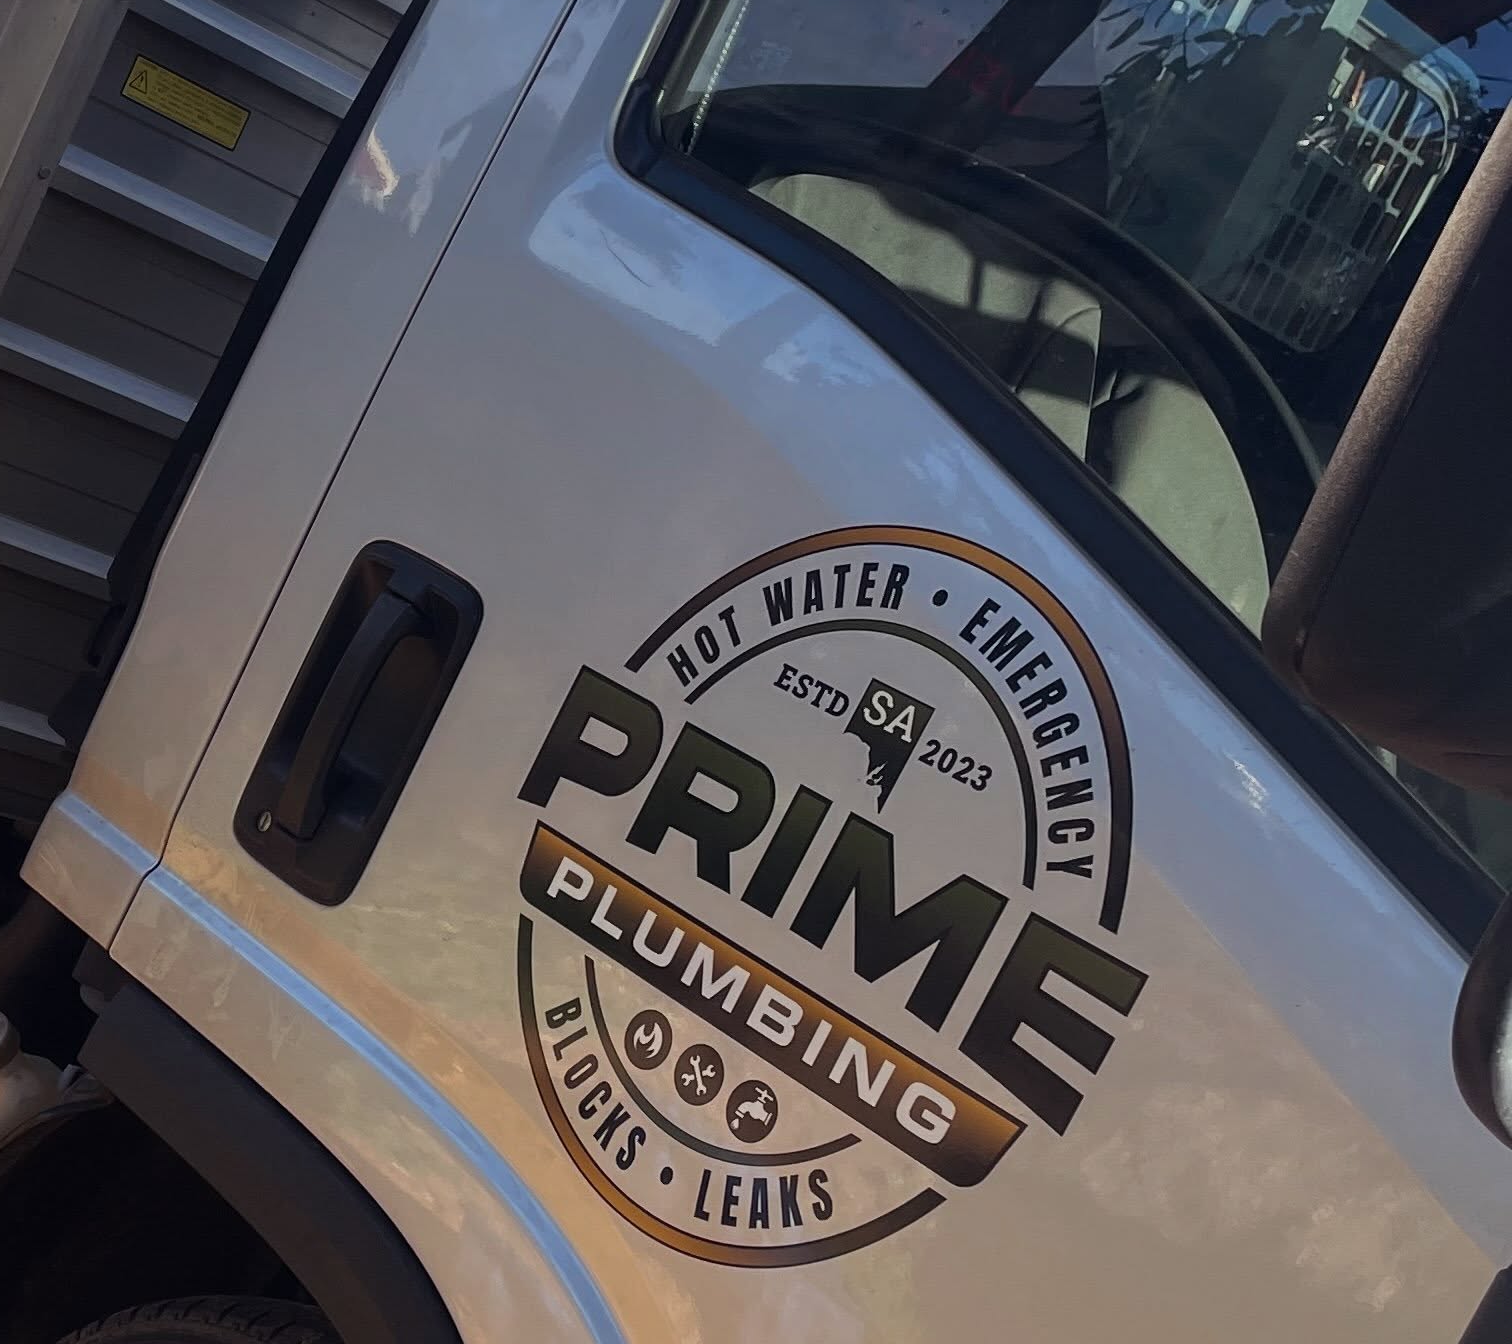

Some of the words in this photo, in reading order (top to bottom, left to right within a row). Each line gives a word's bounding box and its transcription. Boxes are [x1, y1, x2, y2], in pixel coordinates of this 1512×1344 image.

[666, 605, 745, 687] HOT
[762, 561, 912, 624] WATER
[958, 597, 1094, 880] EMERGENCY
[773, 663, 851, 719] ESTD
[862, 689, 916, 744] SA
[917, 739, 995, 793] 2023
[516, 663, 1150, 1138] PRIME
[546, 856, 956, 1145] PLUMBING
[545, 996, 647, 1172] BLOCKS
[694, 1167, 834, 1230] LEAKS
